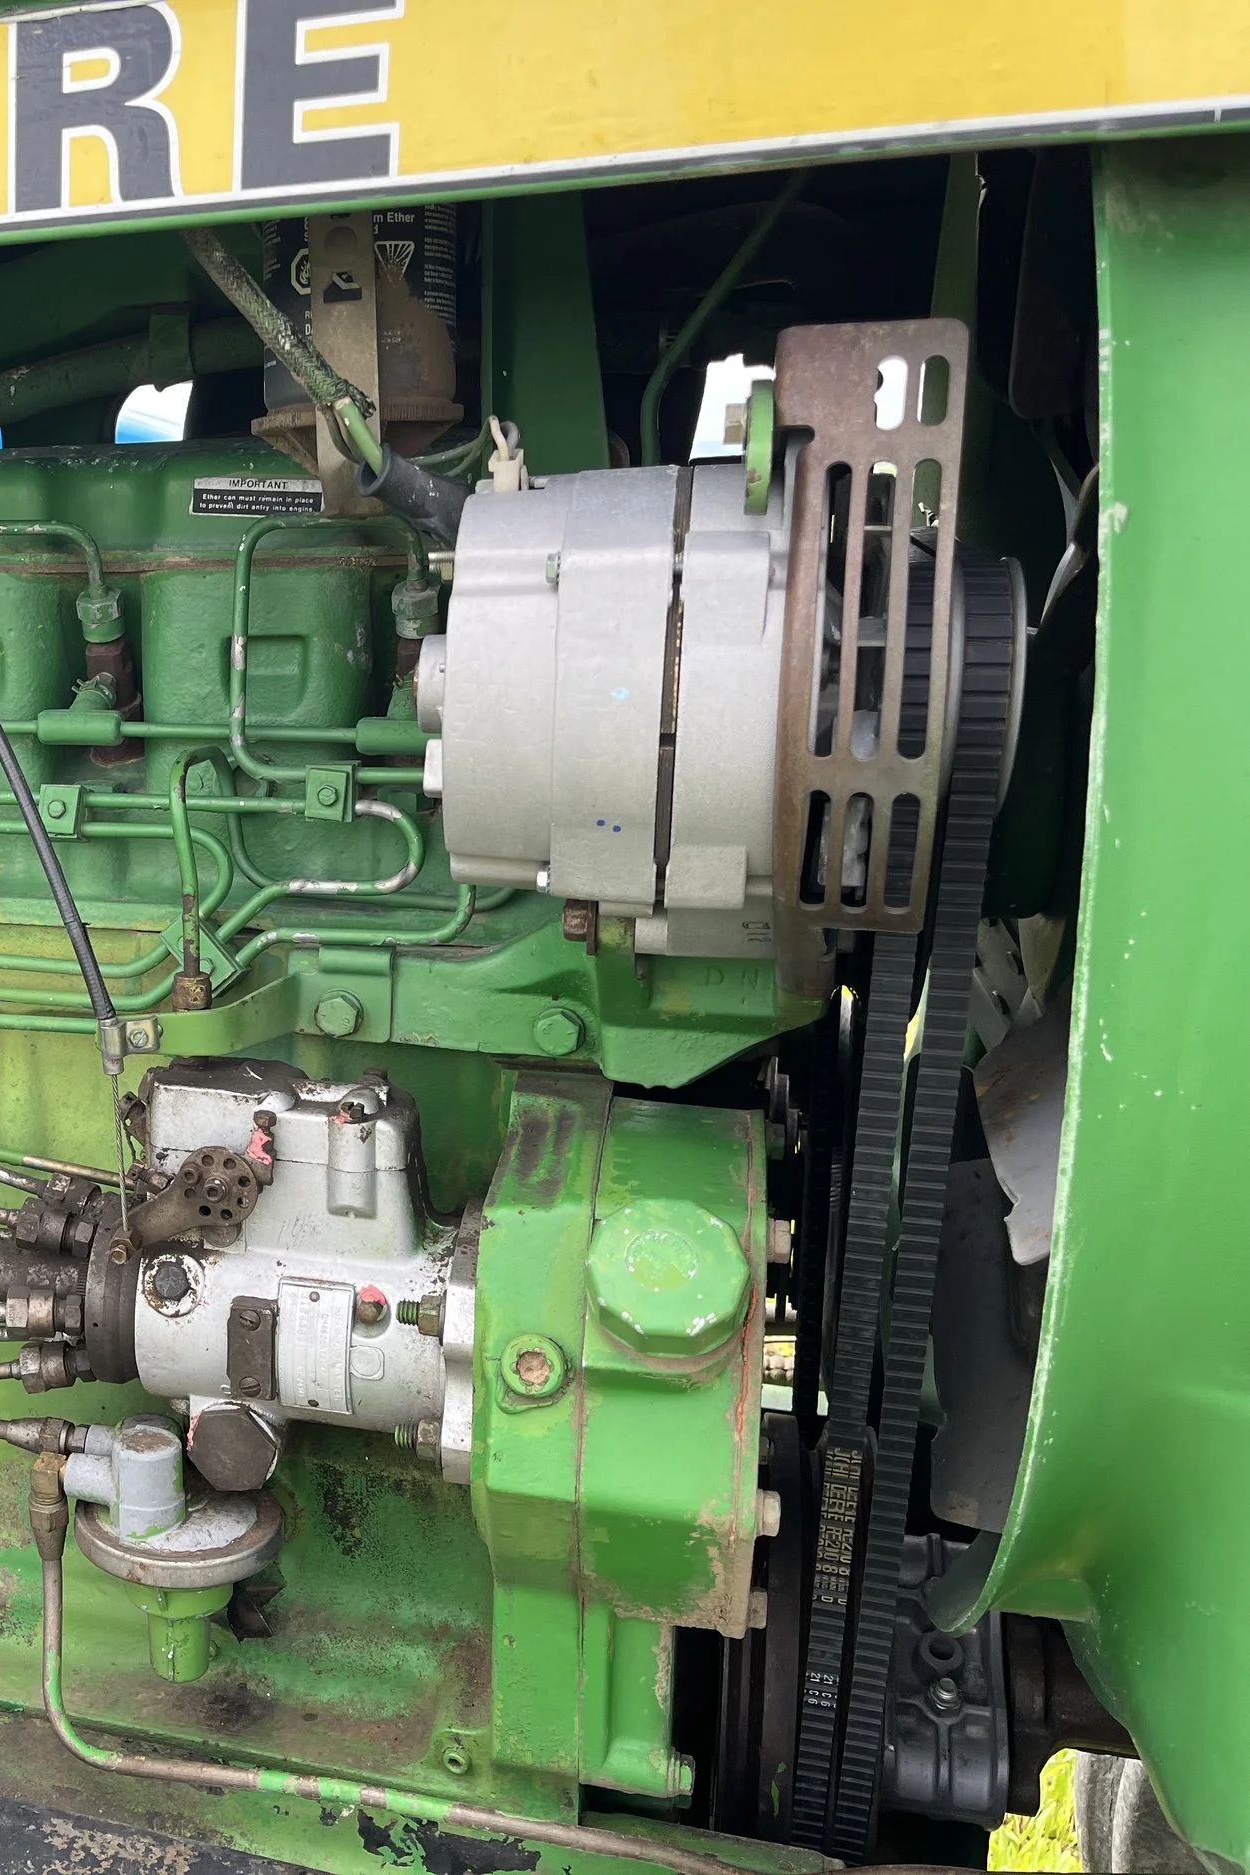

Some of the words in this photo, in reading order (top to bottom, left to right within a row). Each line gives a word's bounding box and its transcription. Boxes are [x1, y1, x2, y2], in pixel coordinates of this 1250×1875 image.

[386, 212, 416, 223] Ether
[229, 479, 288, 490] IMPORTANT
[251, 504, 270, 512] entry
[810, 1672, 821, 1683] 21
[823, 1674, 834, 1685] 21
[820, 1700, 831, 1708] 6
